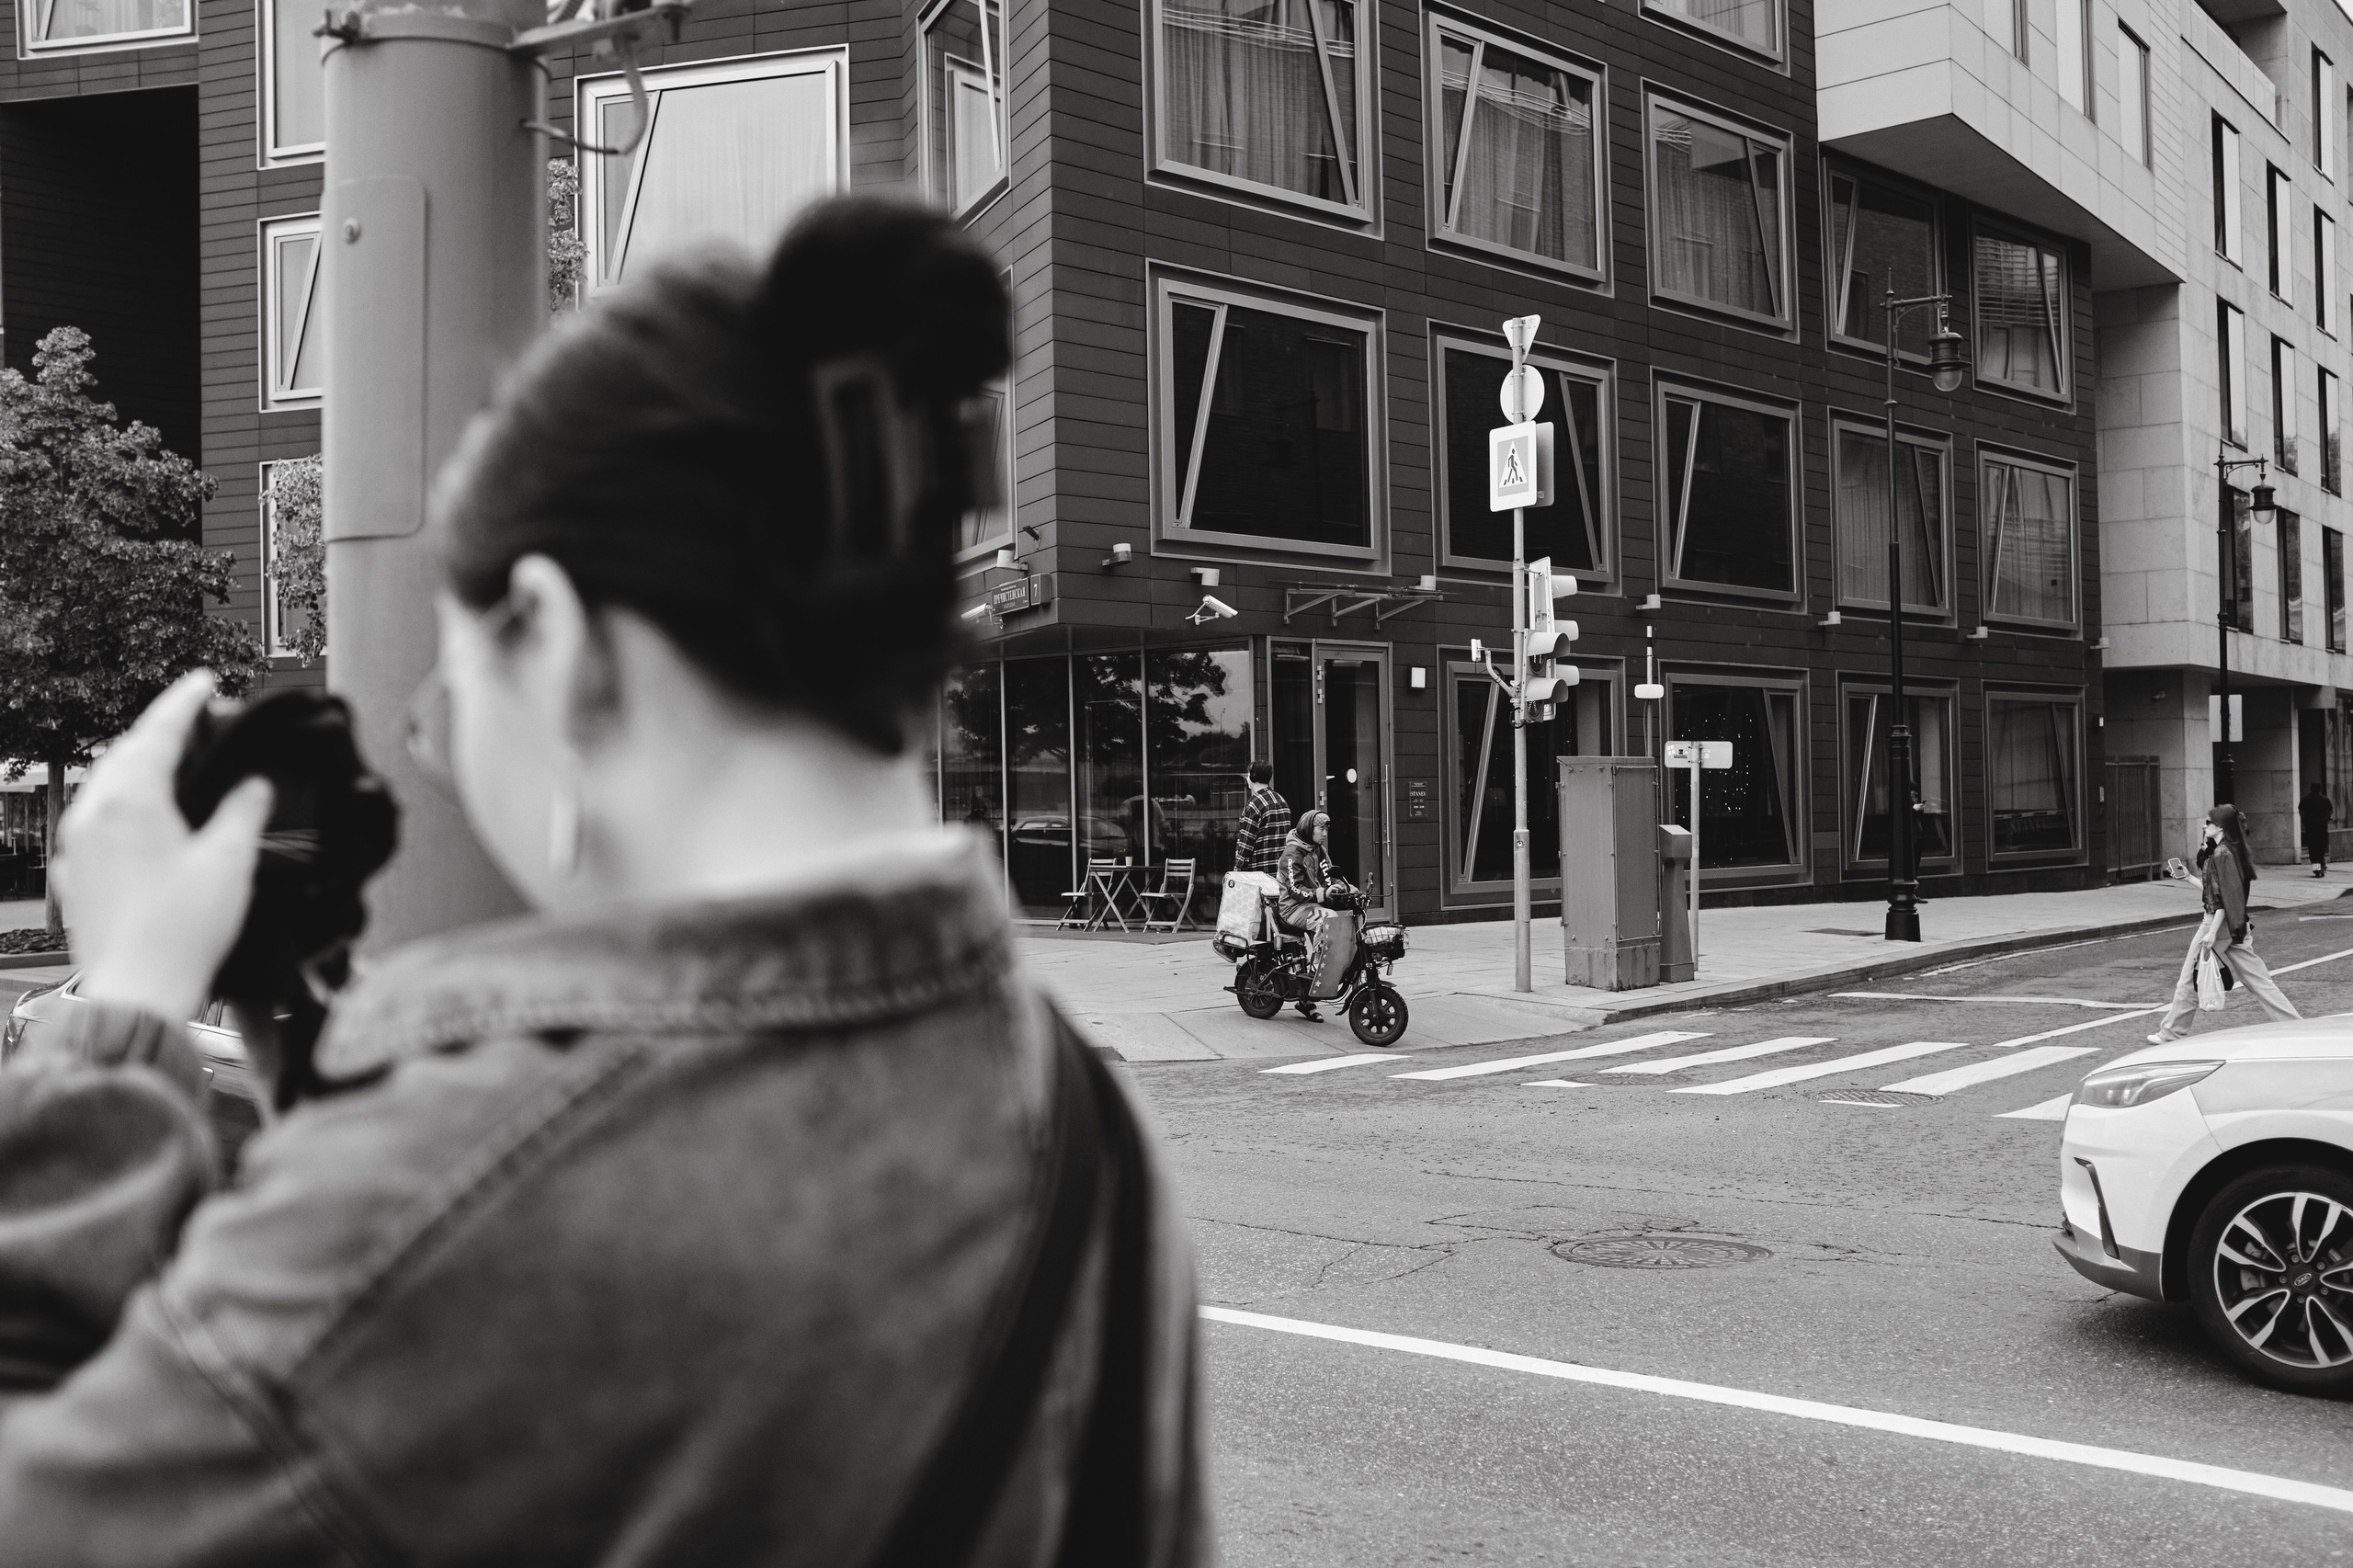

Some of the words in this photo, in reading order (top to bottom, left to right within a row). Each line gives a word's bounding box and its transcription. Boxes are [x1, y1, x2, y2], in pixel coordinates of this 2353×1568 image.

[993, 586, 1026, 605] ПРЕЧИСТЕНСКАЯ
[1033, 583, 1038, 597] 7
[2296, 1274, 2311, 1285] JAC
